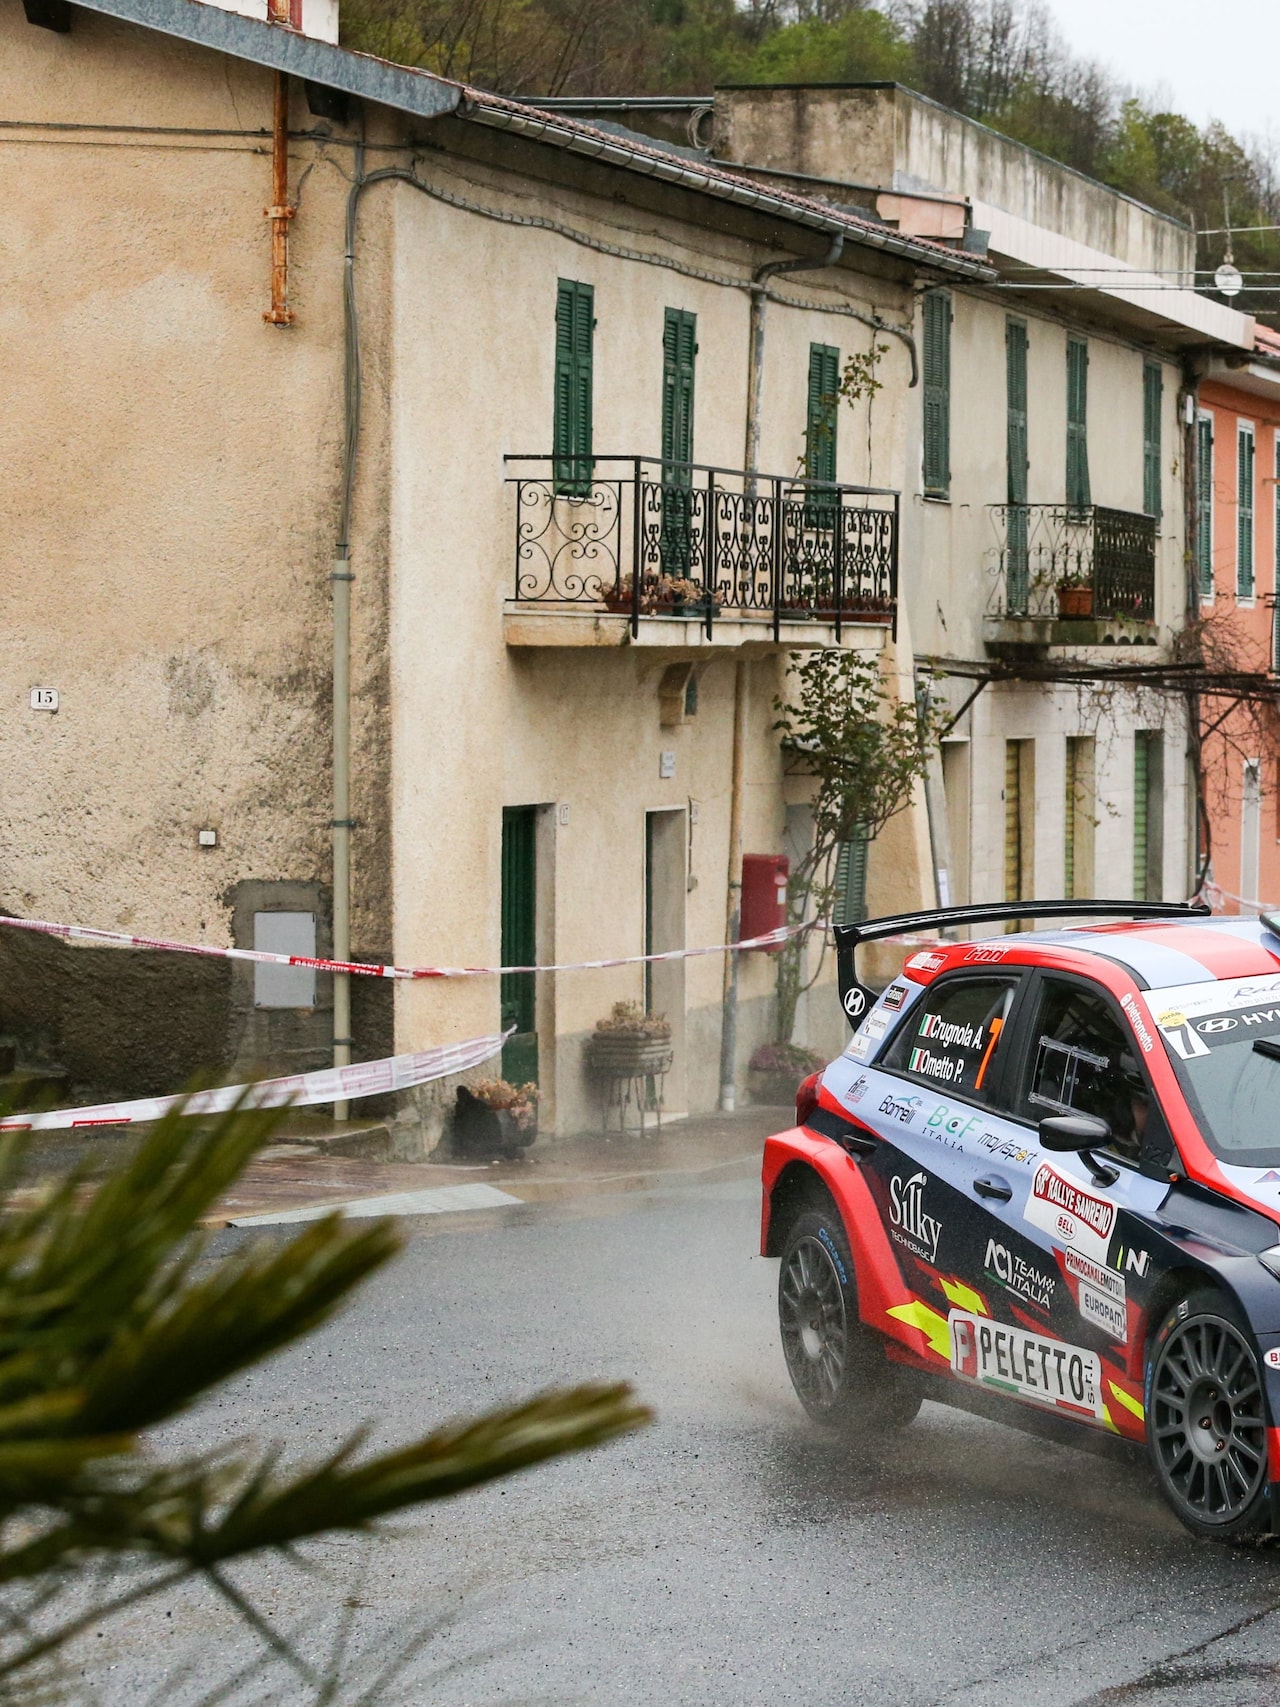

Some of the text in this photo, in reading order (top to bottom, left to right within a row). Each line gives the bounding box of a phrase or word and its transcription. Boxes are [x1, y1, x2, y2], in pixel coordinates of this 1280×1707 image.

[38, 691, 53, 703] 15
[930, 1015, 984, 1050] Crugnola A.
[920, 1049, 965, 1083] Ometto P.
[922, 1127, 964, 1153] ITALIA
[889, 1172, 942, 1263] Silky
[1047, 1175, 1076, 1211] RALLYE
[1074, 1194, 1112, 1236] SANREMO
[1057, 1217, 1073, 1234] BELL
[1014, 1256, 1047, 1289] TEAM
[1012, 1273, 1051, 1309] ITALIA
[980, 1326, 1084, 1401] PELETTO
